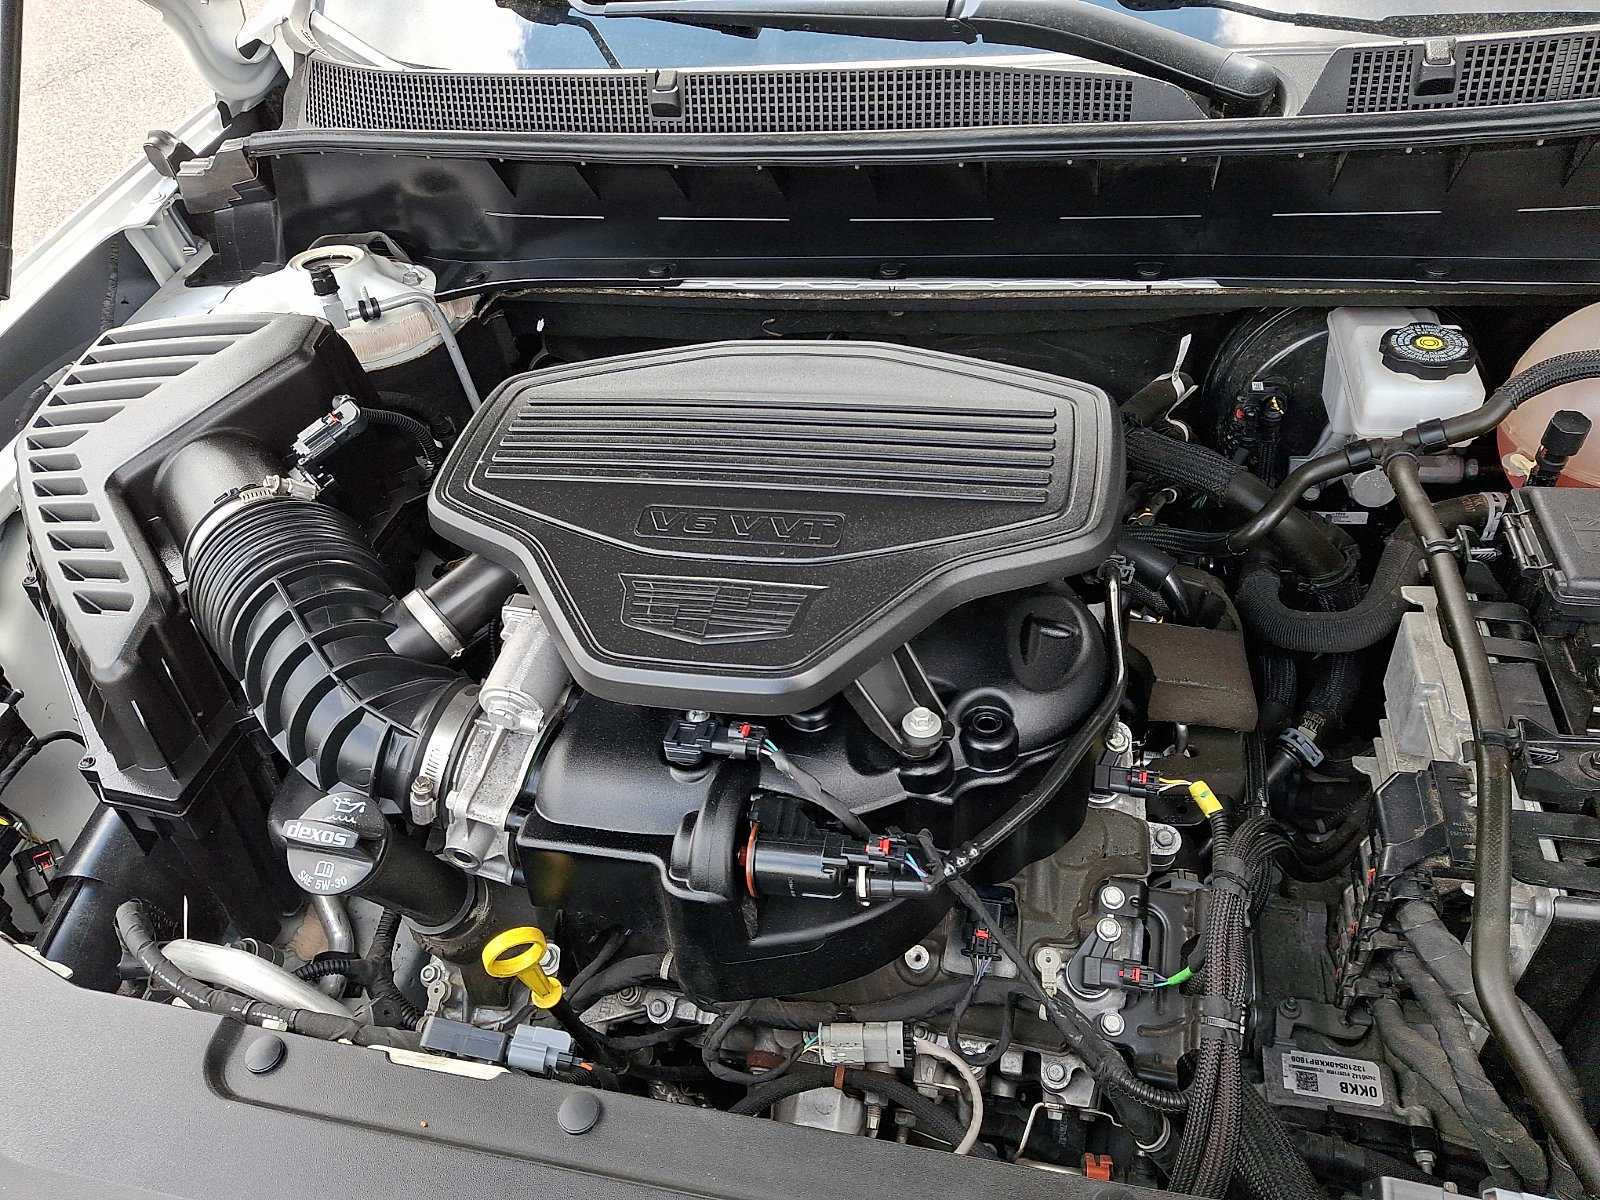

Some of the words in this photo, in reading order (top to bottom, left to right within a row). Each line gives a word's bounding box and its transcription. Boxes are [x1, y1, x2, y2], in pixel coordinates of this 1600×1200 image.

[650, 510, 718, 533] V6
[729, 514, 838, 540] VVT
[286, 822, 347, 845] dexos
[298, 870, 313, 886] SAE
[315, 875, 347, 890] 5W-30
